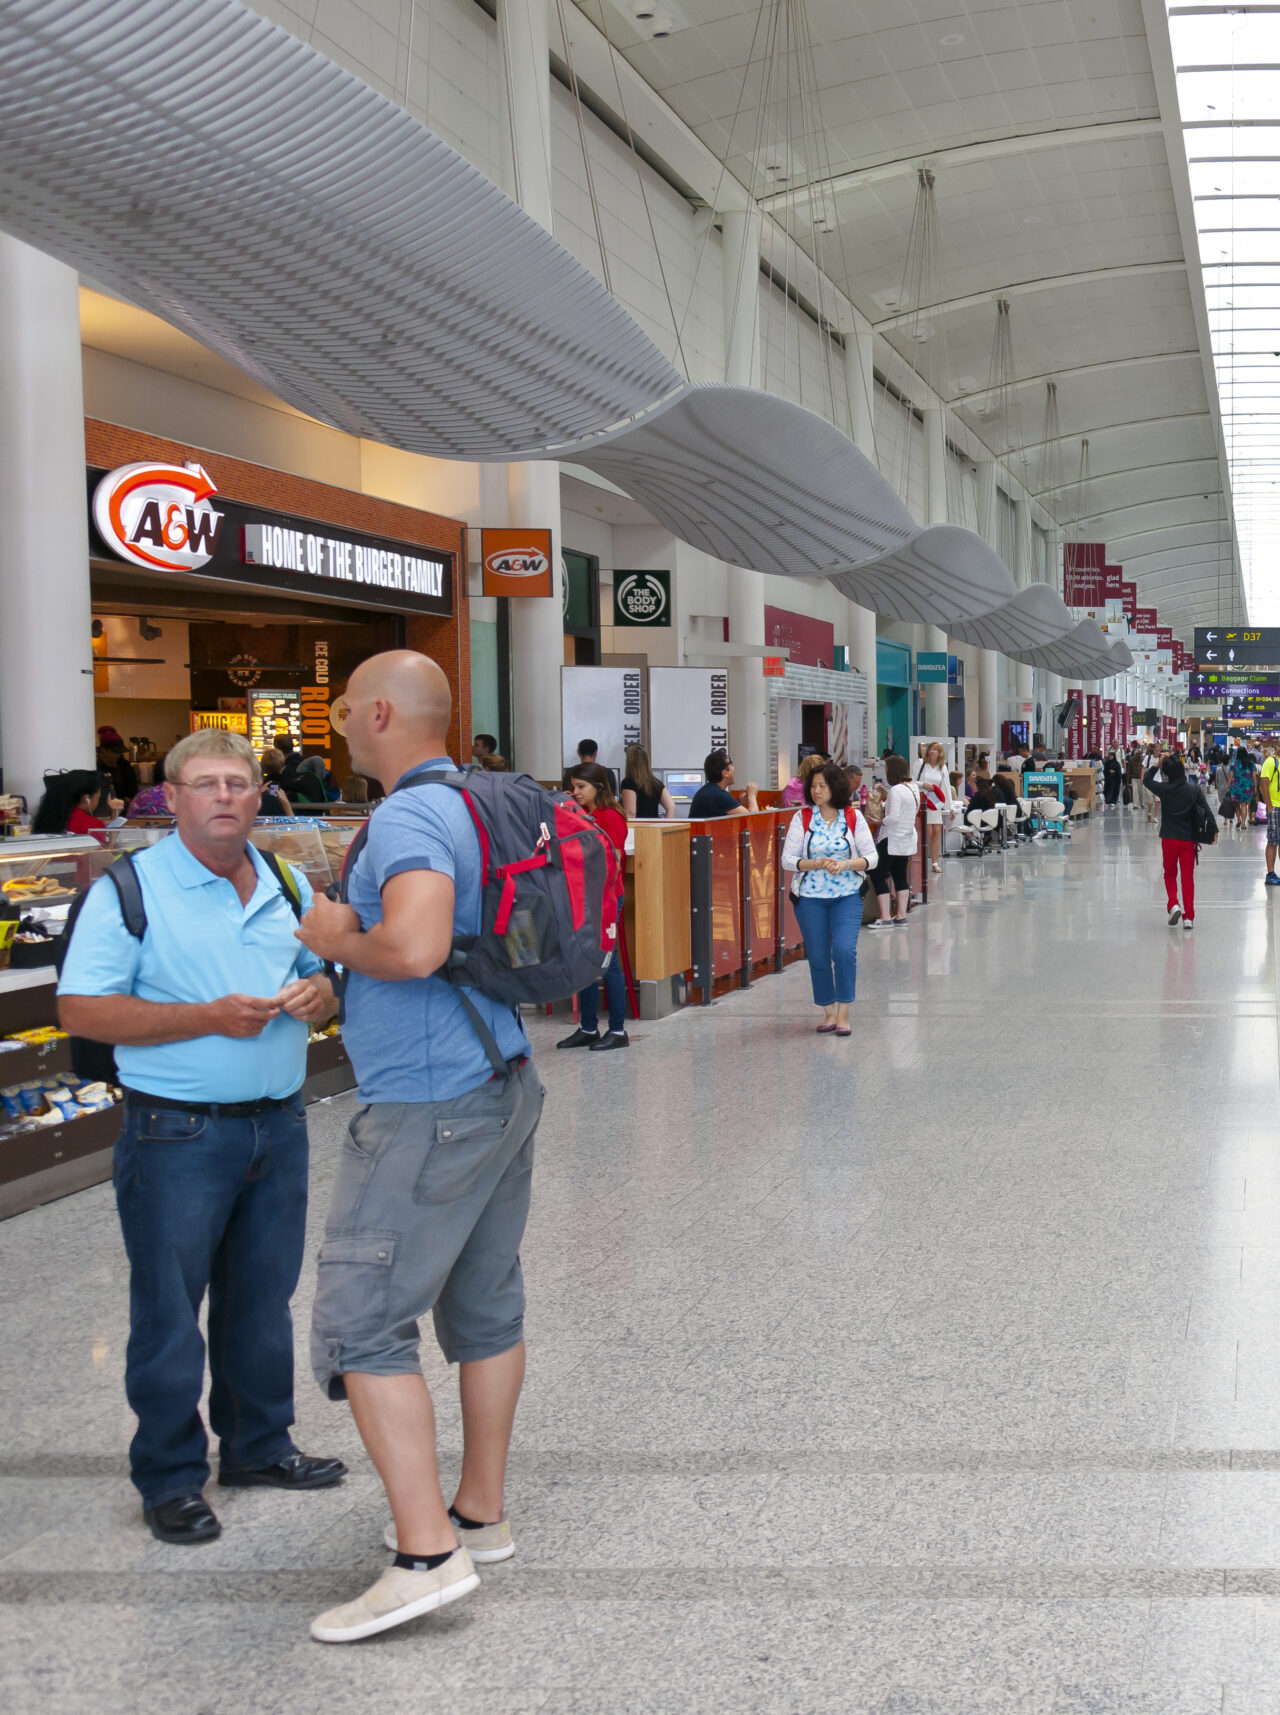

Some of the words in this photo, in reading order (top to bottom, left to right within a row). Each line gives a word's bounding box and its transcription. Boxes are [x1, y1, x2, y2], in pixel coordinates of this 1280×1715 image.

[130, 497, 225, 557] A&W
[262, 524, 305, 572] HOME
[306, 533, 325, 576] OF
[326, 538, 353, 581] THE
[354, 544, 403, 591] BURGER
[404, 556, 444, 598] FAMILY
[494, 558, 544, 572] A&W
[627, 596, 657, 605] BODY
[632, 588, 651, 597] THE
[628, 604, 656, 614] SHOP
[1243, 632, 1262, 641] D37
[315, 641, 329, 657] ICE
[315, 658, 329, 684] COLD
[1221, 675, 1249, 683] Baggage
[623, 673, 641, 715] ORDER
[710, 674, 727, 715] ORDER
[1221, 687, 1260, 695] Connections
[200, 715, 228, 731] MUG
[300, 686, 331, 749] ROOT
[624, 724, 641, 752] ELF
